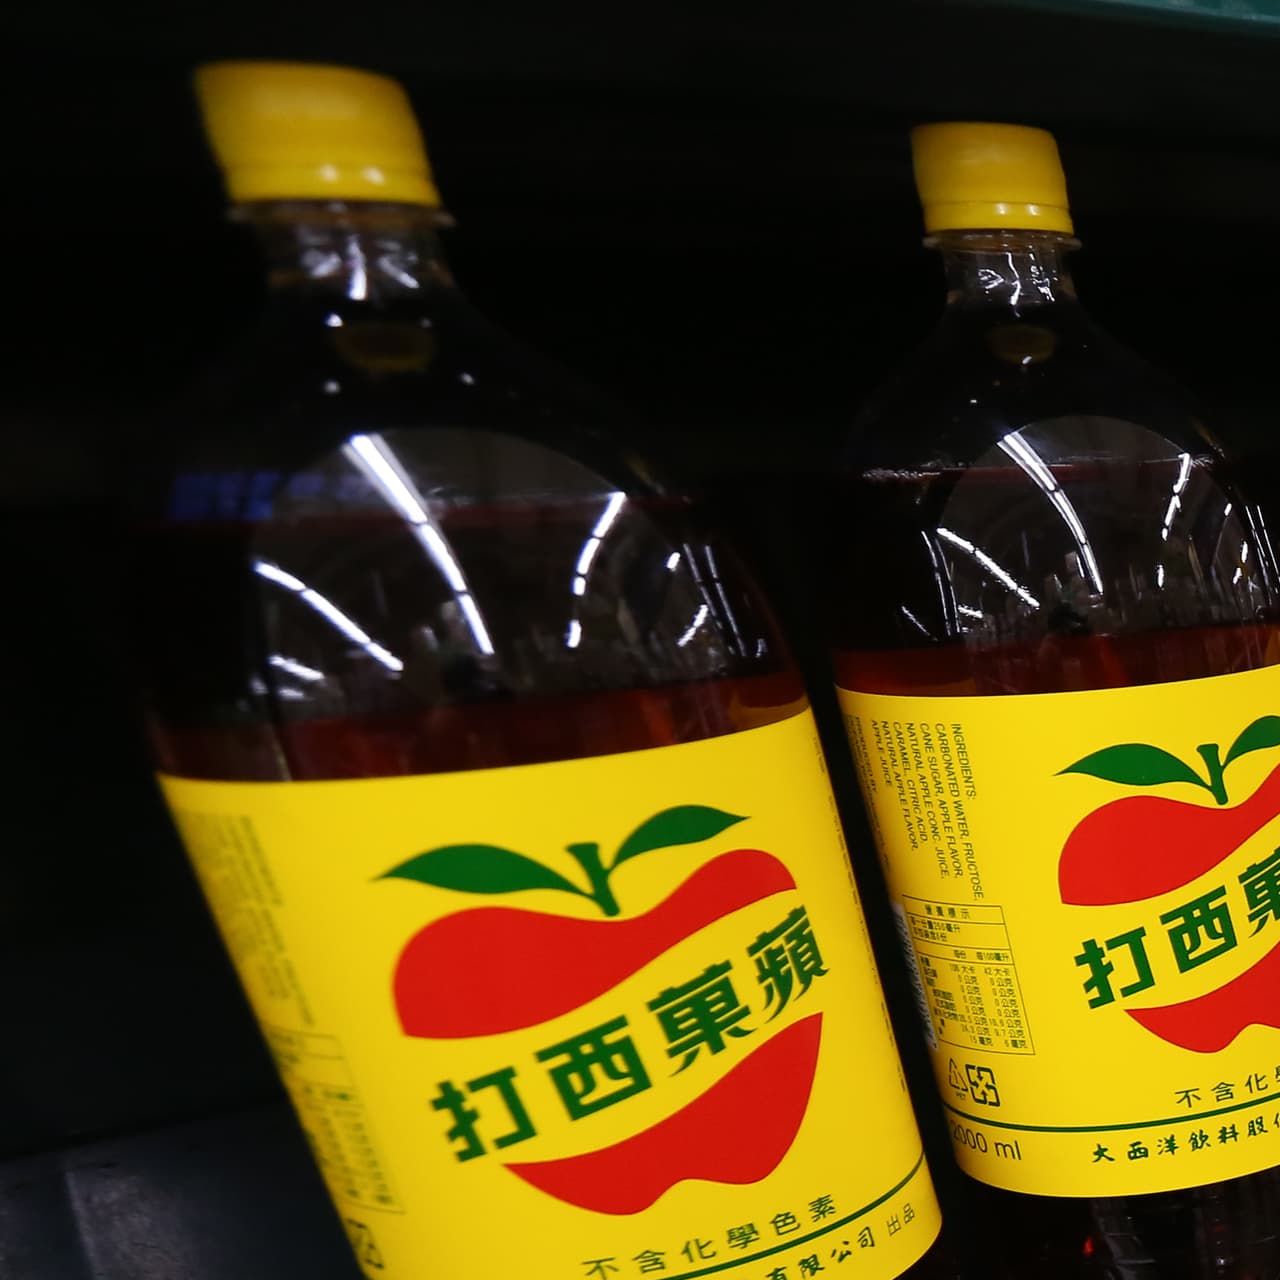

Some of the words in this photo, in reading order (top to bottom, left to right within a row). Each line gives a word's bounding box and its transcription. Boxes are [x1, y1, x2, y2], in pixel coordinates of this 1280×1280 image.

[881, 721, 898, 769] NATURAL
[895, 772, 908, 805] APPLE
[906, 723, 924, 773] NATURAL
[920, 775, 934, 808] APPLE
[908, 780, 921, 814] CITRIC
[920, 723, 934, 753] CANE
[938, 800, 953, 832] APPLE
[935, 723, 959, 797] CARBONATED
[994, 1140, 1022, 1161] ml
